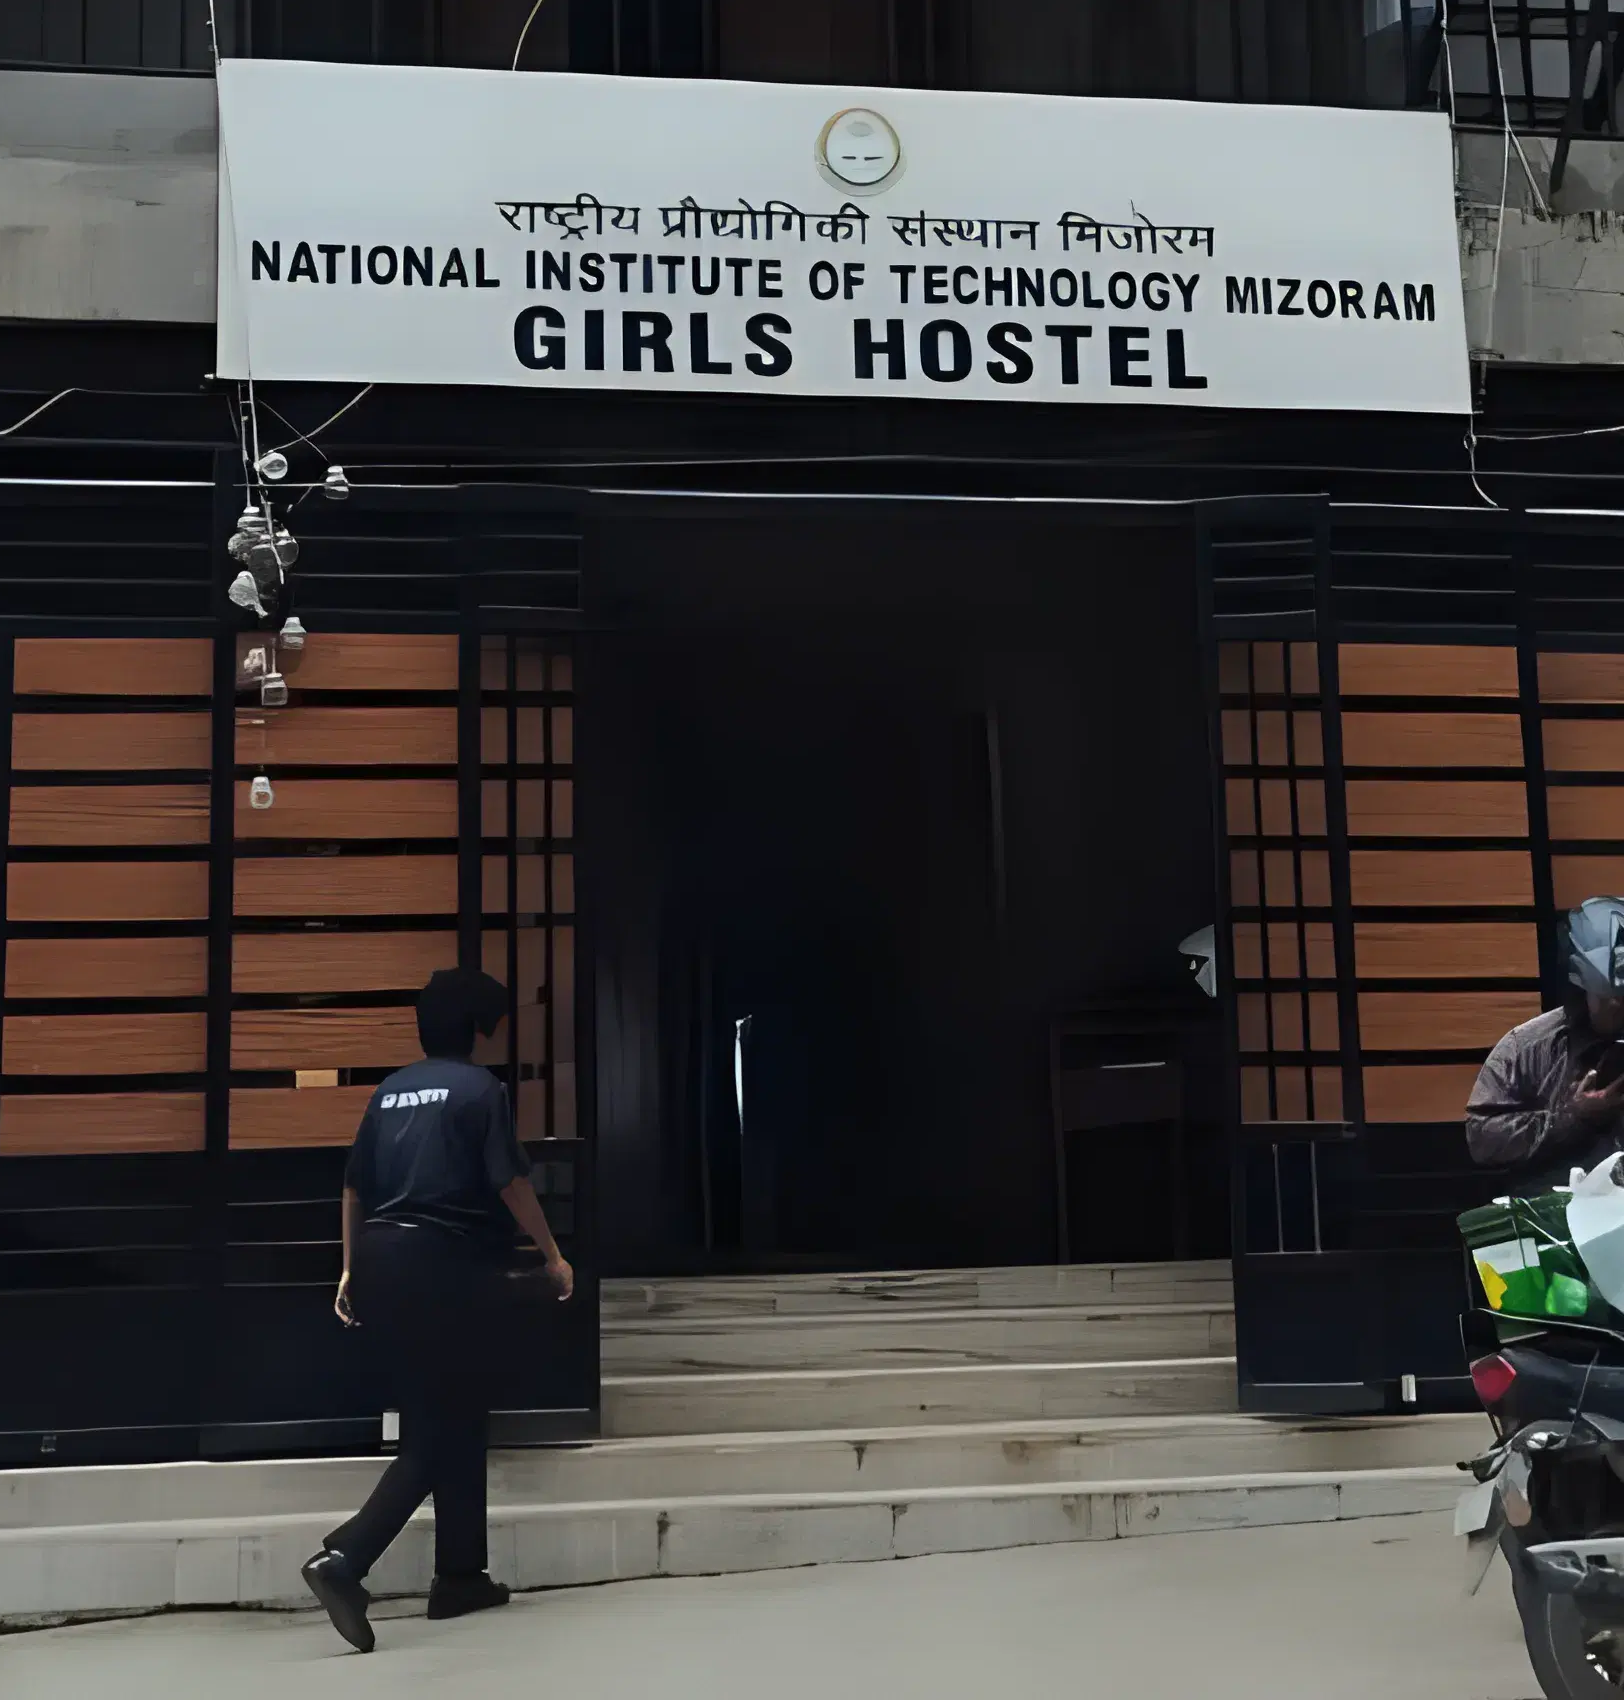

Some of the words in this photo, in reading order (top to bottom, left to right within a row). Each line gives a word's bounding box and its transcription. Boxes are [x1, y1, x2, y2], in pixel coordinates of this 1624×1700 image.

[494, 192, 641, 241] राष्ट्रीय
[886, 209, 1041, 251] संस्थान
[1056, 209, 1215, 258] मिजोरम
[251, 240, 501, 288] NATIONAL
[526, 249, 784, 299] INSTITUTE
[808, 260, 866, 301] OF
[889, 264, 1200, 313] TECHNOLOGY
[1225, 275, 1436, 322] MIZORAM
[513, 305, 793, 378] GIRLS
[853, 318, 1208, 390] HOSTEL
